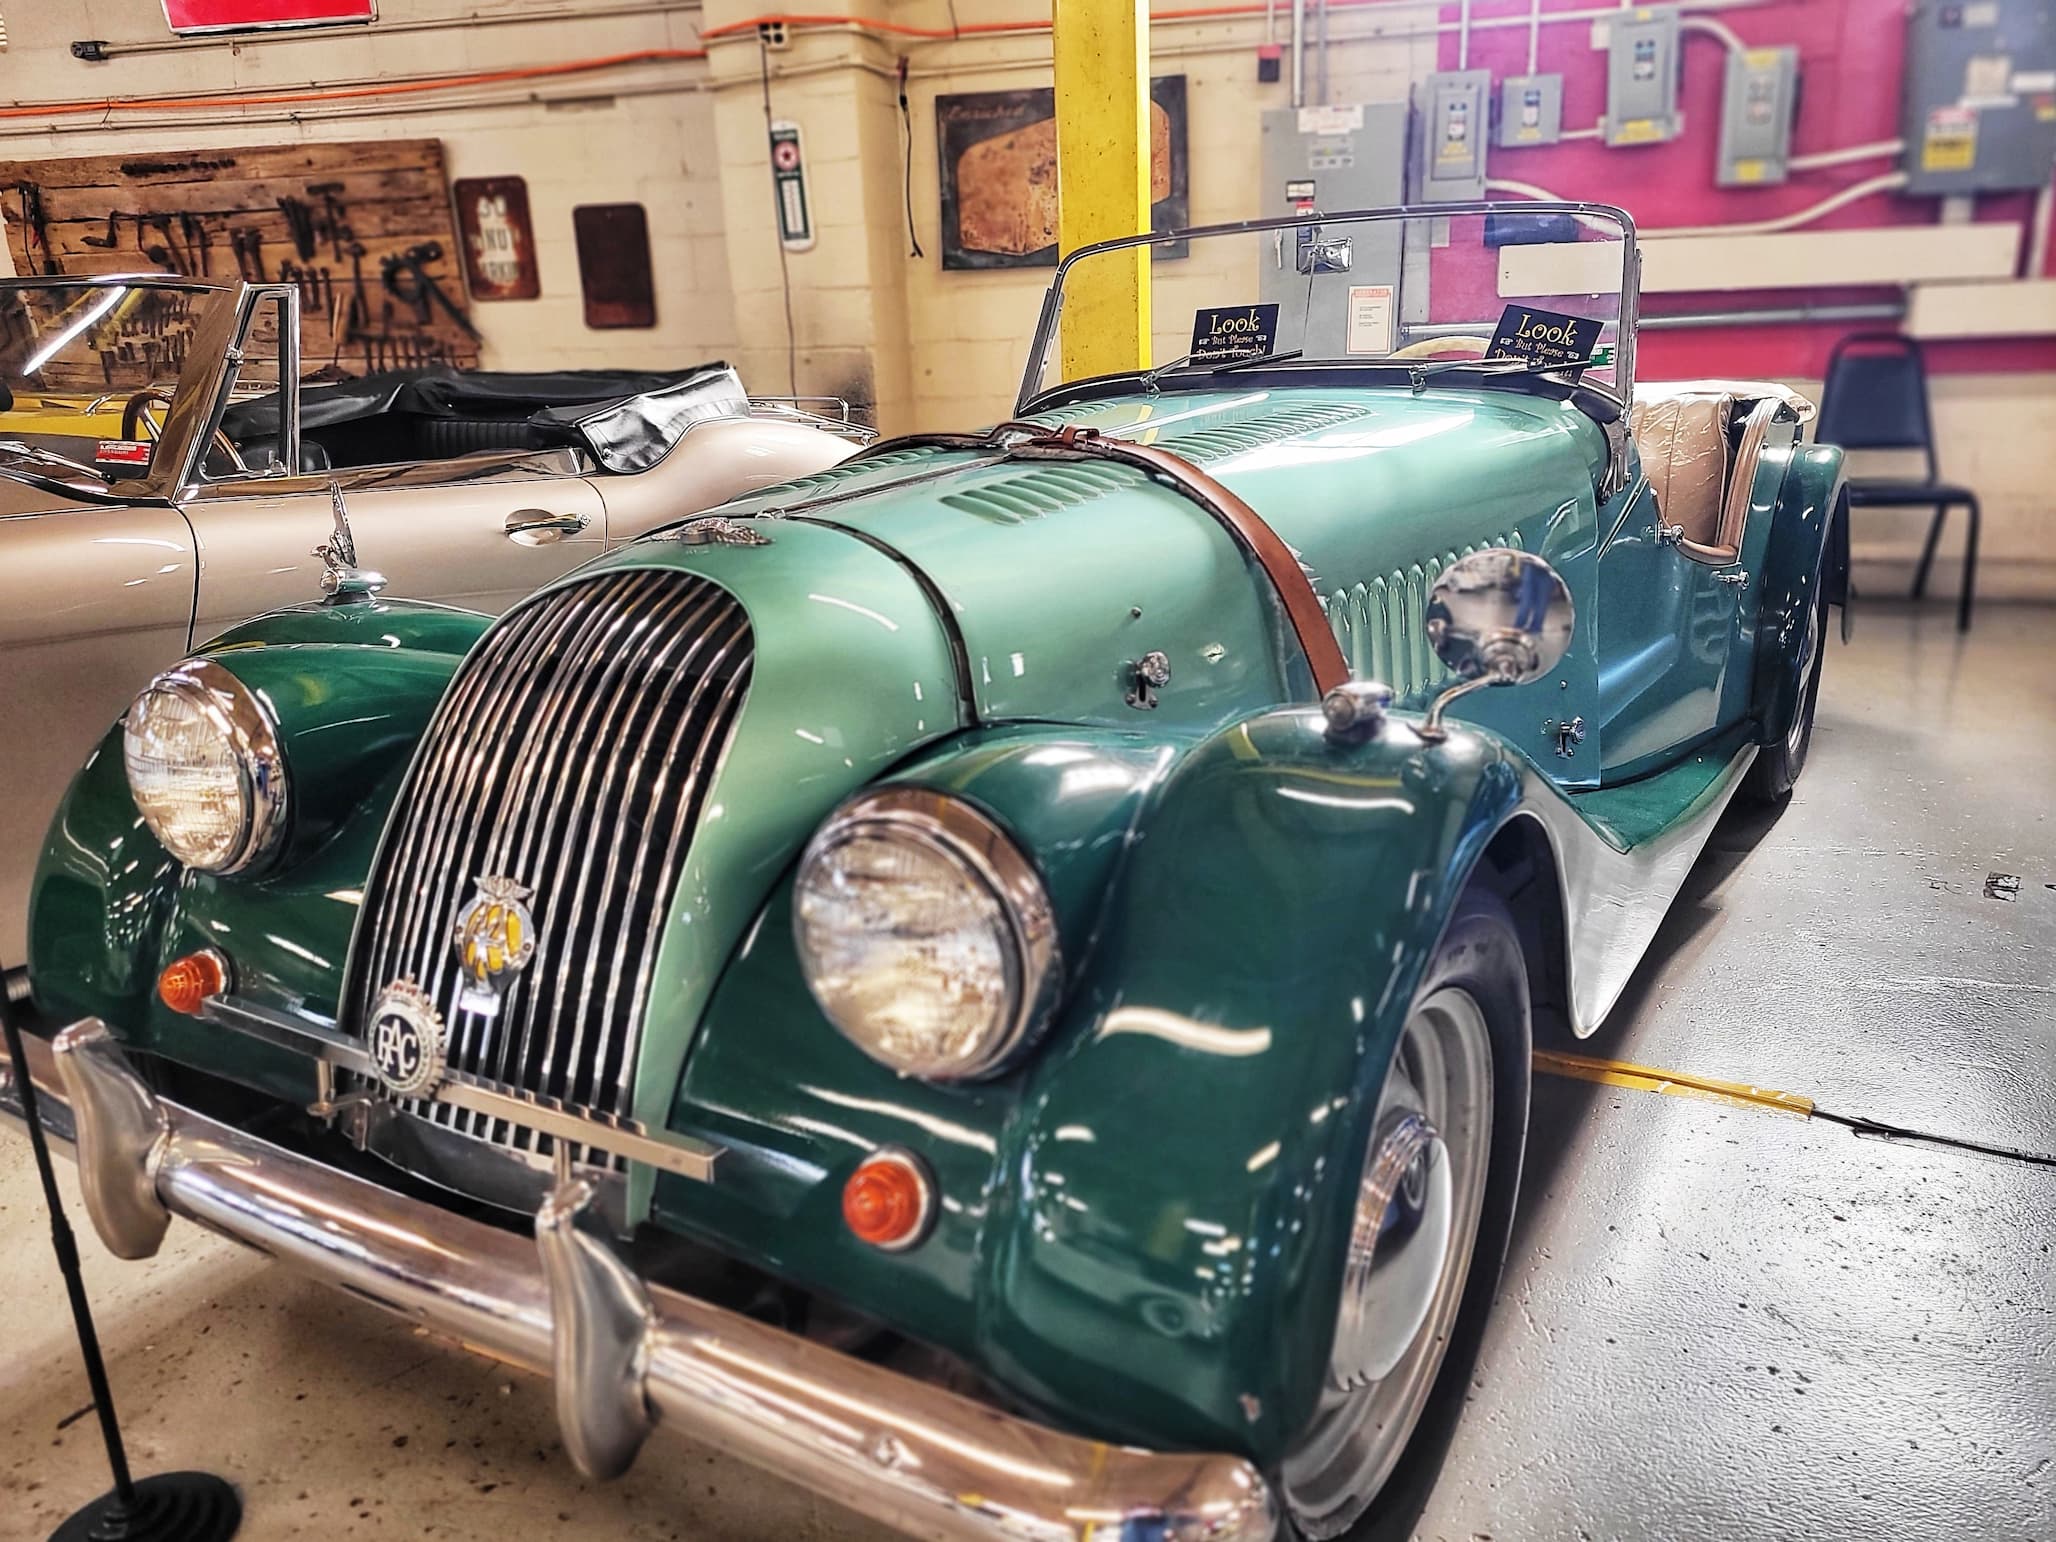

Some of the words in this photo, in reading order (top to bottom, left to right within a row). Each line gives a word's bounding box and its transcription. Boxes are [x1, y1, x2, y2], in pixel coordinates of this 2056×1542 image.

[1209, 309, 1261, 335] Look
[1515, 313, 1578, 346] Look
[1212, 336, 1226, 345] But
[1229, 334, 1254, 344] Please
[1515, 338, 1532, 351] But
[1535, 342, 1564, 357] Please
[377, 1018, 417, 1078] RAC
